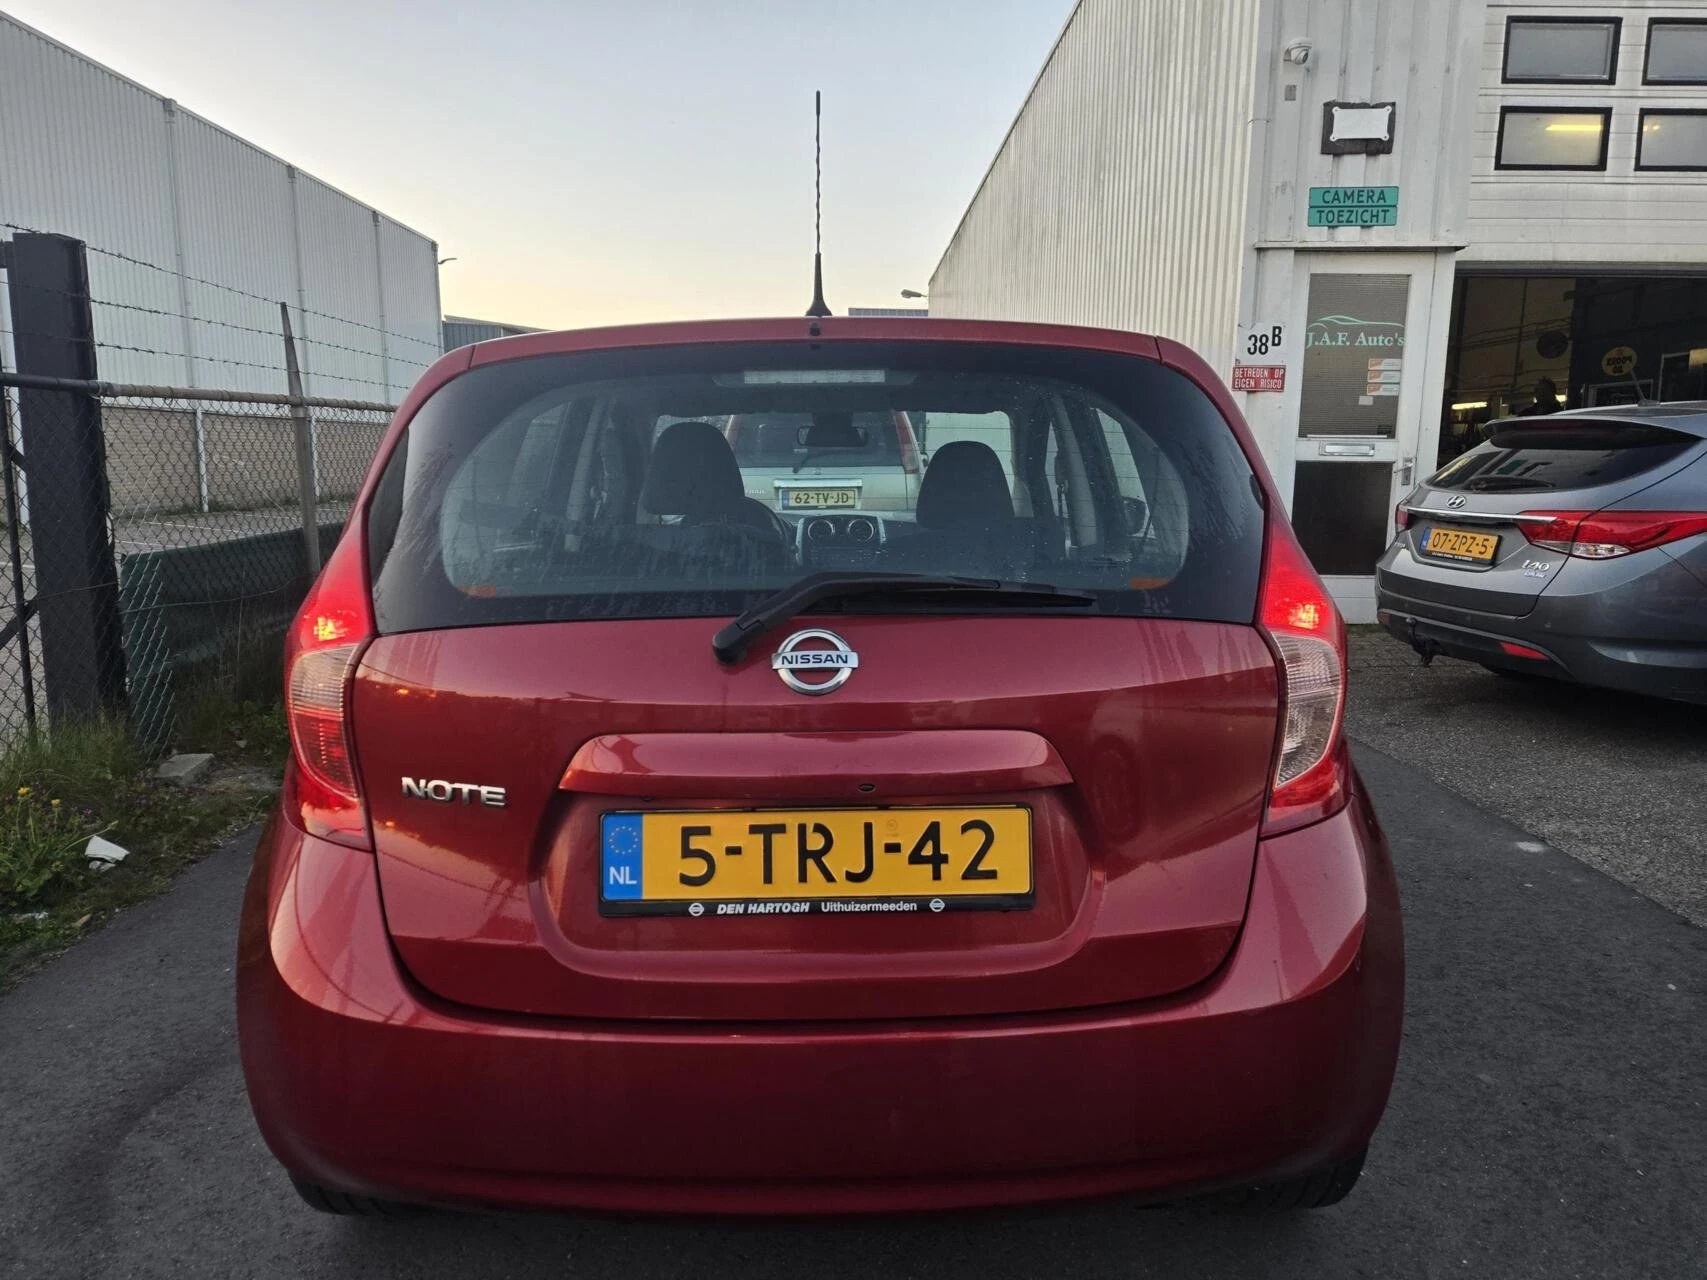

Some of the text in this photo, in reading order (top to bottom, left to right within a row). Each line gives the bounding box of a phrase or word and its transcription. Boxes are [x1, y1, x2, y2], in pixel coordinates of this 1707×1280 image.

[1322, 189, 1387, 204] CAMERA
[1316, 209, 1390, 223] TOEZICHT
[1306, 331, 1404, 349] J.A.F. Auto's
[1234, 367, 1285, 378] BETREDEN OP
[1234, 379, 1282, 389] EIGEN RISICO
[794, 492, 850, 504] 62-TV-JD
[1432, 531, 1490, 555] 07-ZPZ-5
[781, 654, 848, 665] NISSAN
[401, 776, 506, 806] NOTE
[678, 819, 998, 887] 5-TRJ-42
[609, 867, 637, 885] NL
[716, 901, 917, 914] DEN HARTOGH Uithuizermeeden
